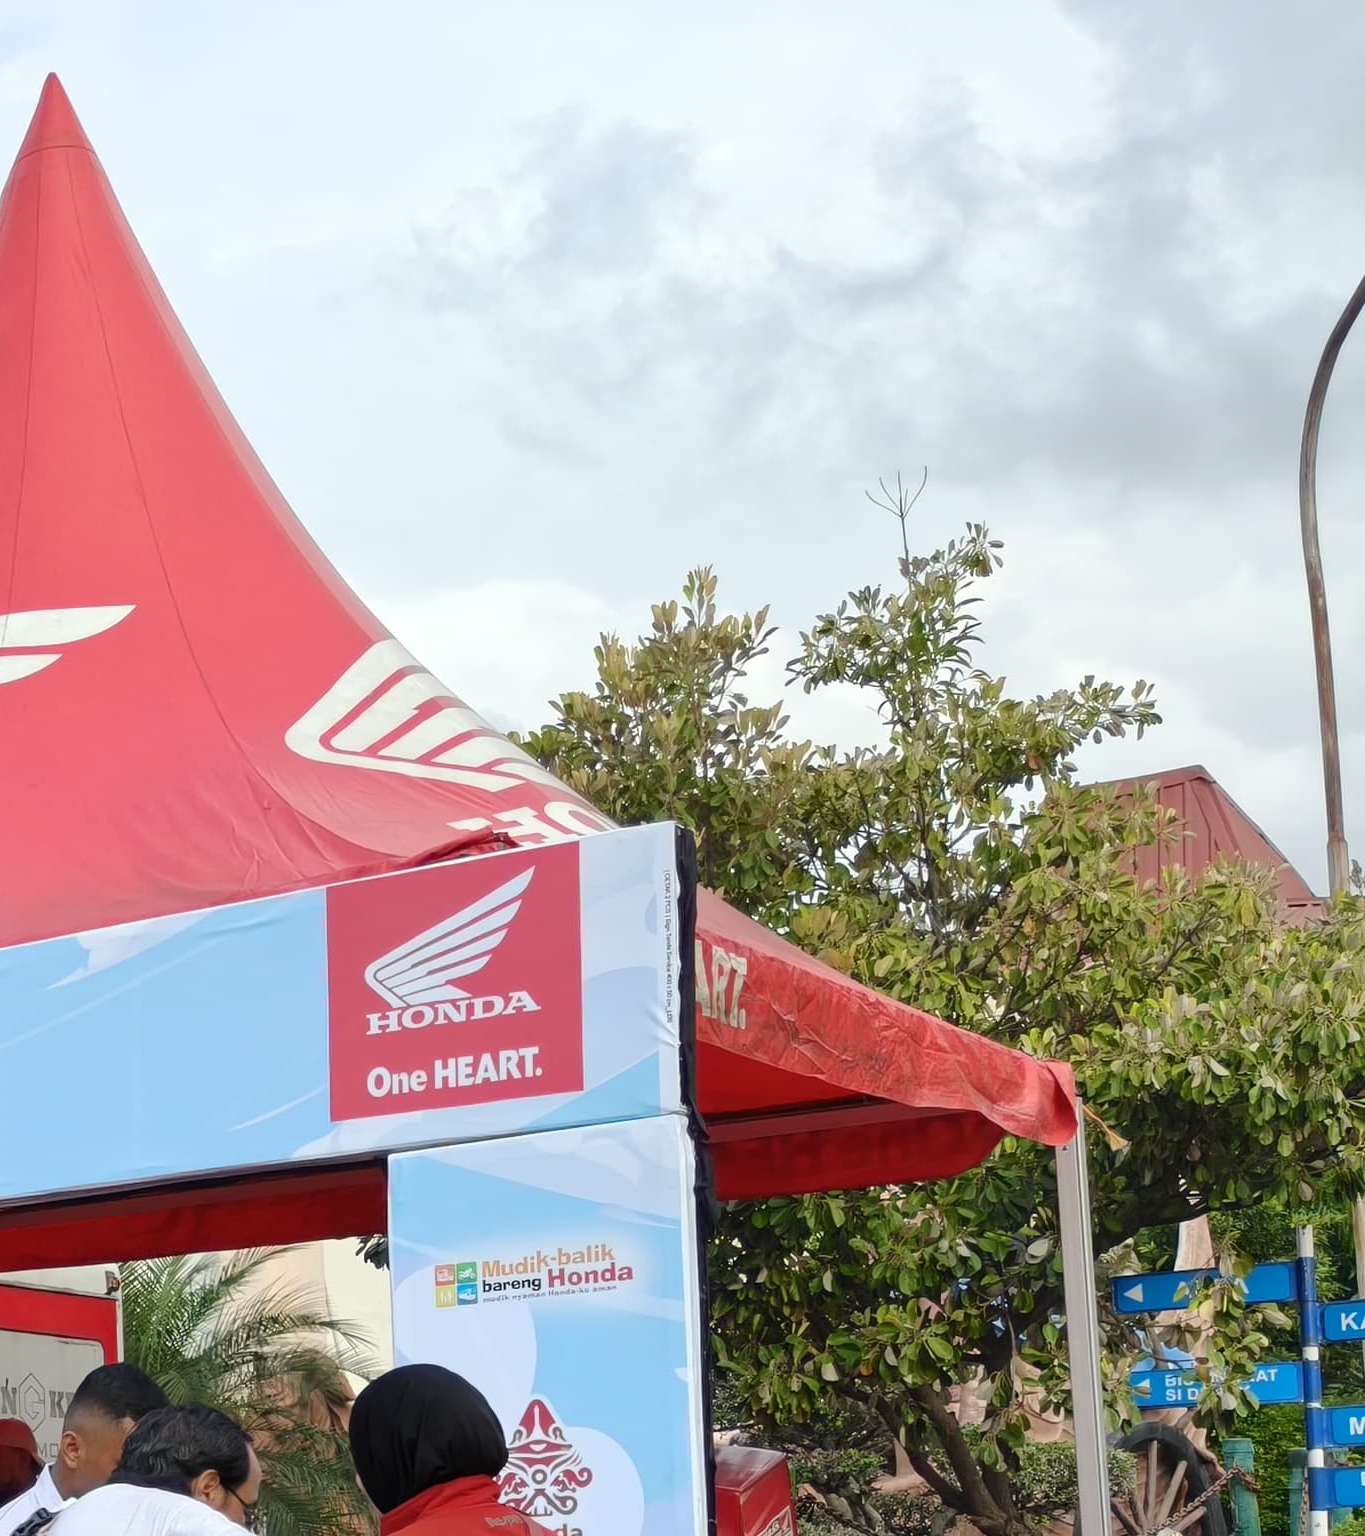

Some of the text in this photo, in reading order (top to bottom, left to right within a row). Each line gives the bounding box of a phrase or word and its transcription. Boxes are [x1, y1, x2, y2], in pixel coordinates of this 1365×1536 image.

[693, 938, 748, 1031] ART.
[366, 990, 542, 1036] HONDA
[366, 1046, 544, 1098] One HEART.
[482, 1244, 615, 1279] Mudik-balik
[482, 1262, 634, 1294] bareng Honda
